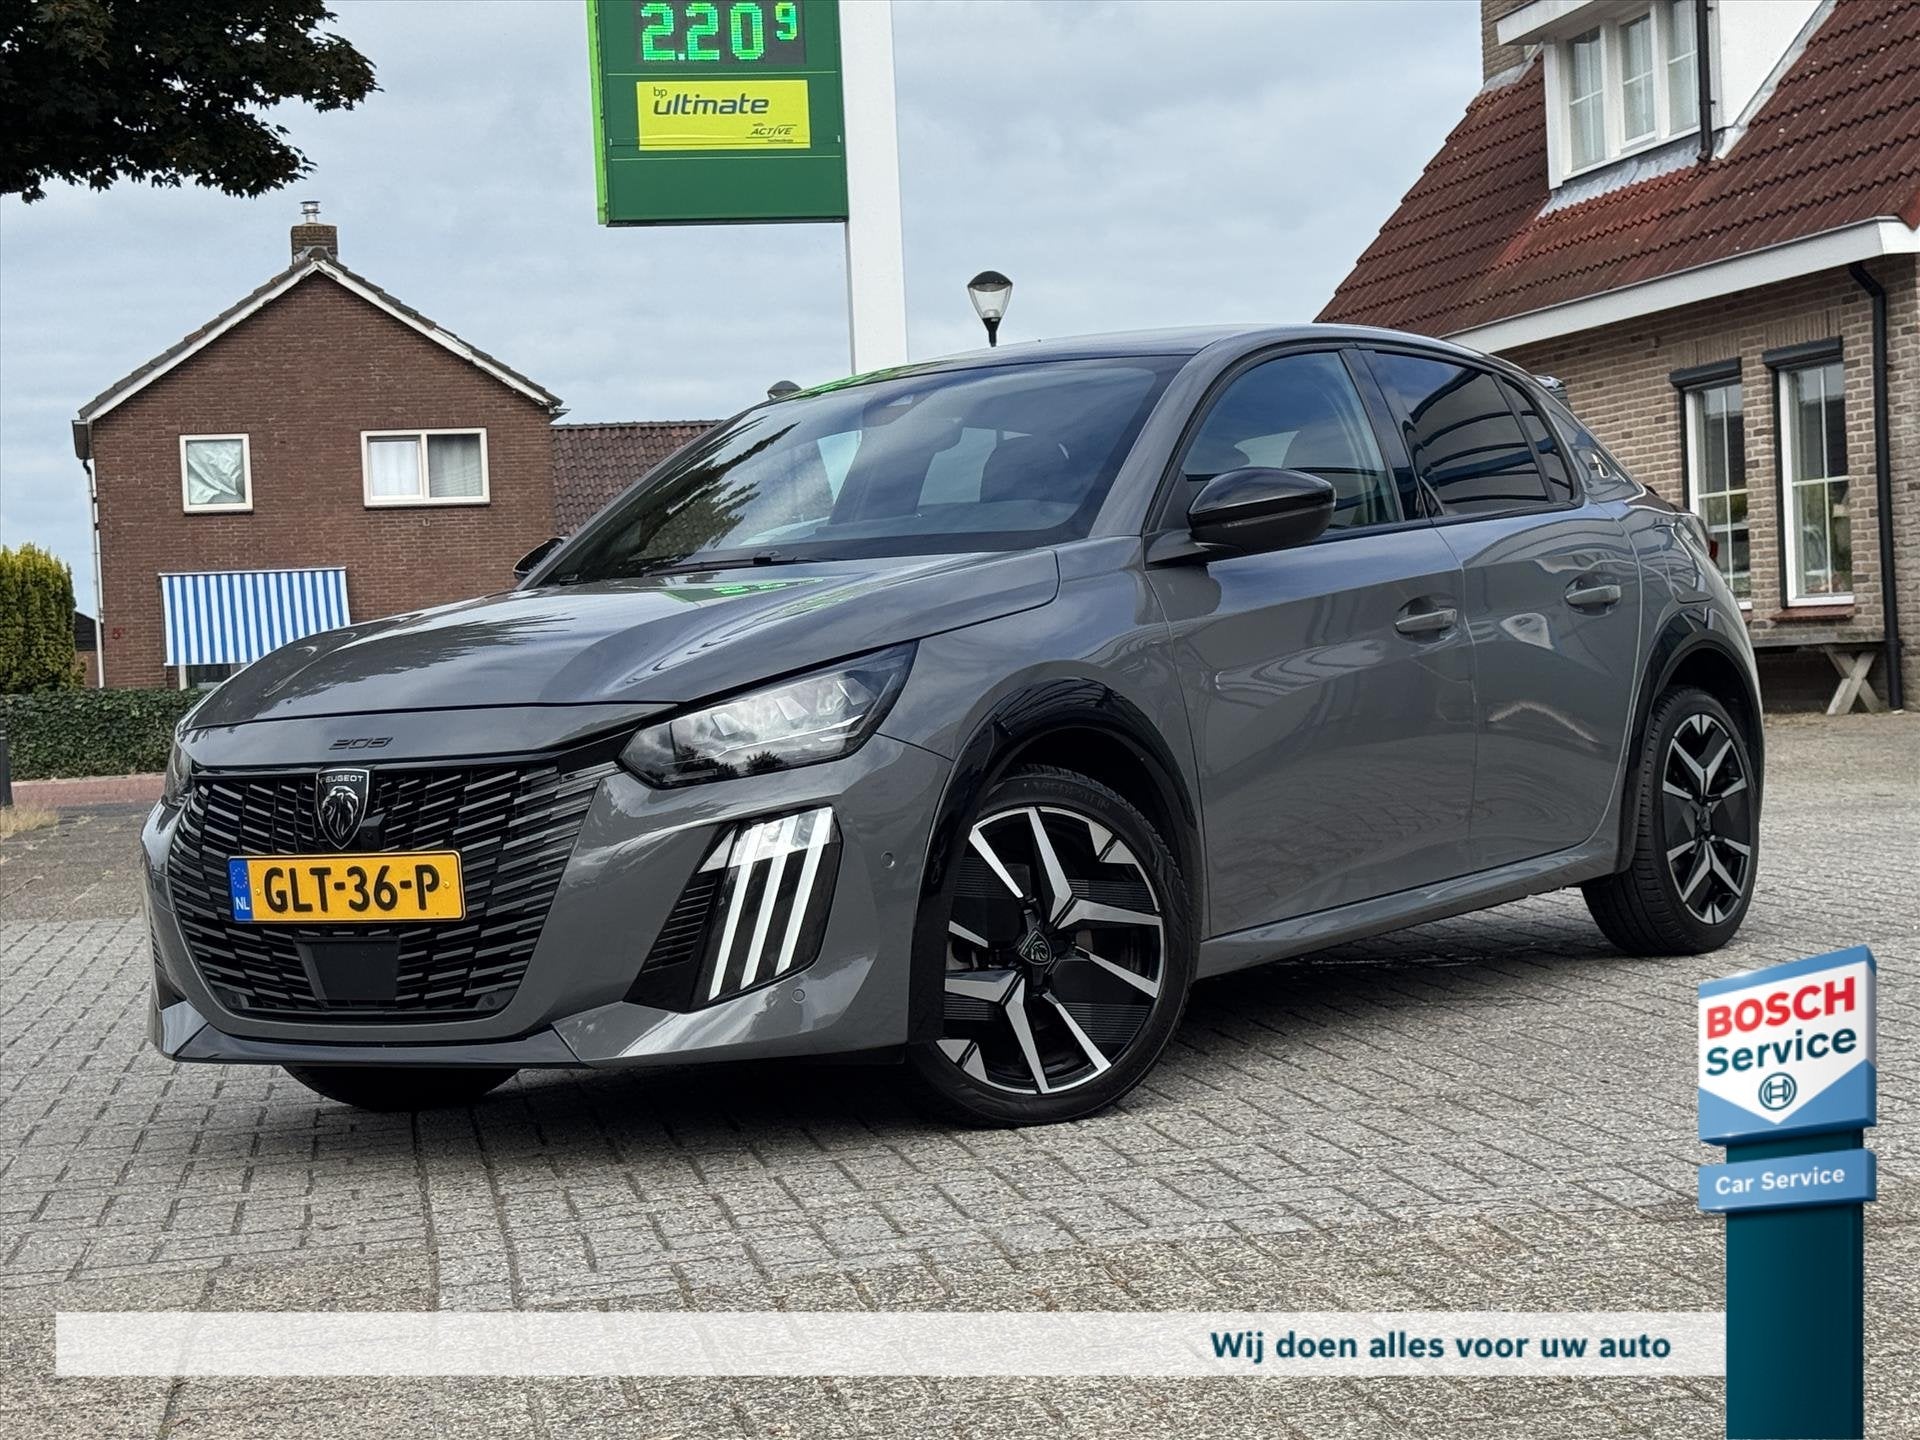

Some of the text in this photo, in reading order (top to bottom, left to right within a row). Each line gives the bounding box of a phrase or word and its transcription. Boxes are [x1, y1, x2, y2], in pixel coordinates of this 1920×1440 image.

[653, 86, 668, 98] bp
[653, 93, 770, 115] ultimate
[750, 126, 794, 136] ACTIVE
[328, 736, 394, 751] 208
[319, 774, 364, 783] PEUGEOT
[264, 864, 440, 913] GLT-36-P
[235, 896, 250, 911] NL
